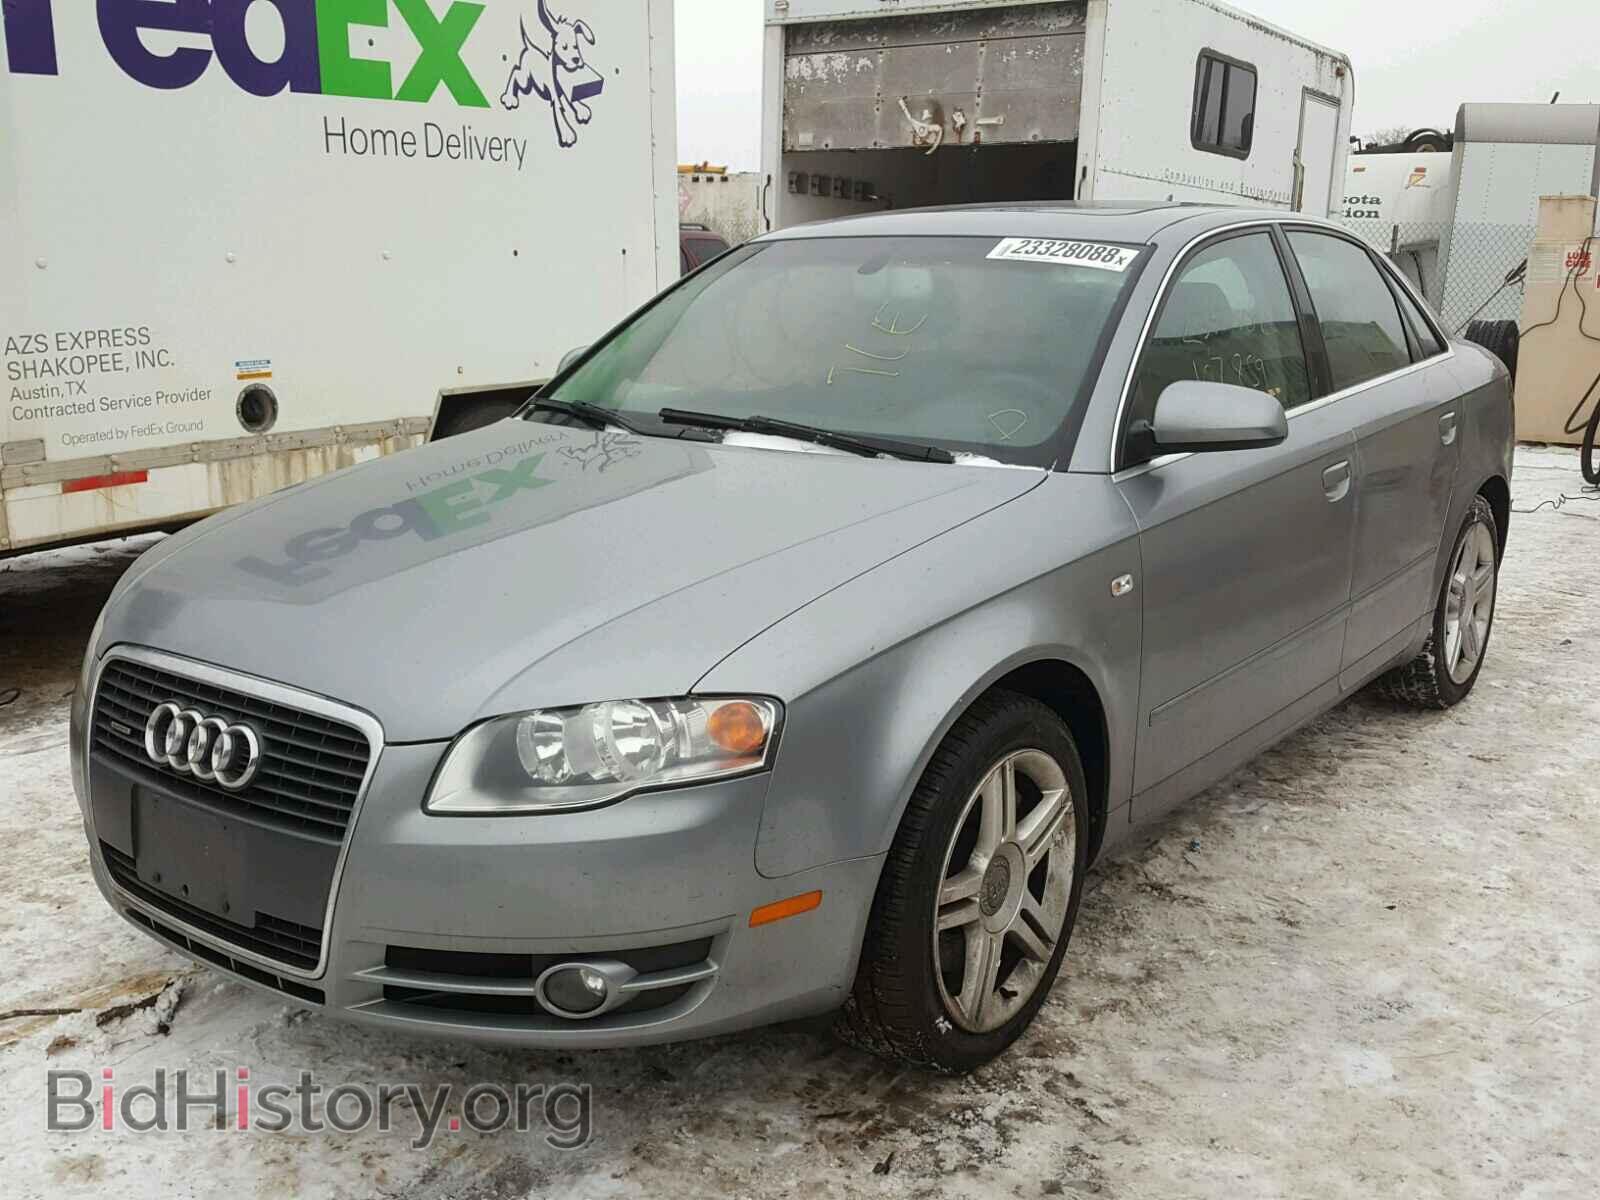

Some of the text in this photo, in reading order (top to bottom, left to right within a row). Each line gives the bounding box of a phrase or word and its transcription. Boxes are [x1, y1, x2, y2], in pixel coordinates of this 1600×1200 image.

[323, 115, 527, 171] Home Delivery
[4, 326, 151, 356] AZS EXPRESS
[7, 349, 175, 381] SHAKOPEE, INC.
[12, 387, 212, 421] Contracted Service Provider
[61, 418, 204, 447] Operated by FedEx Ground
